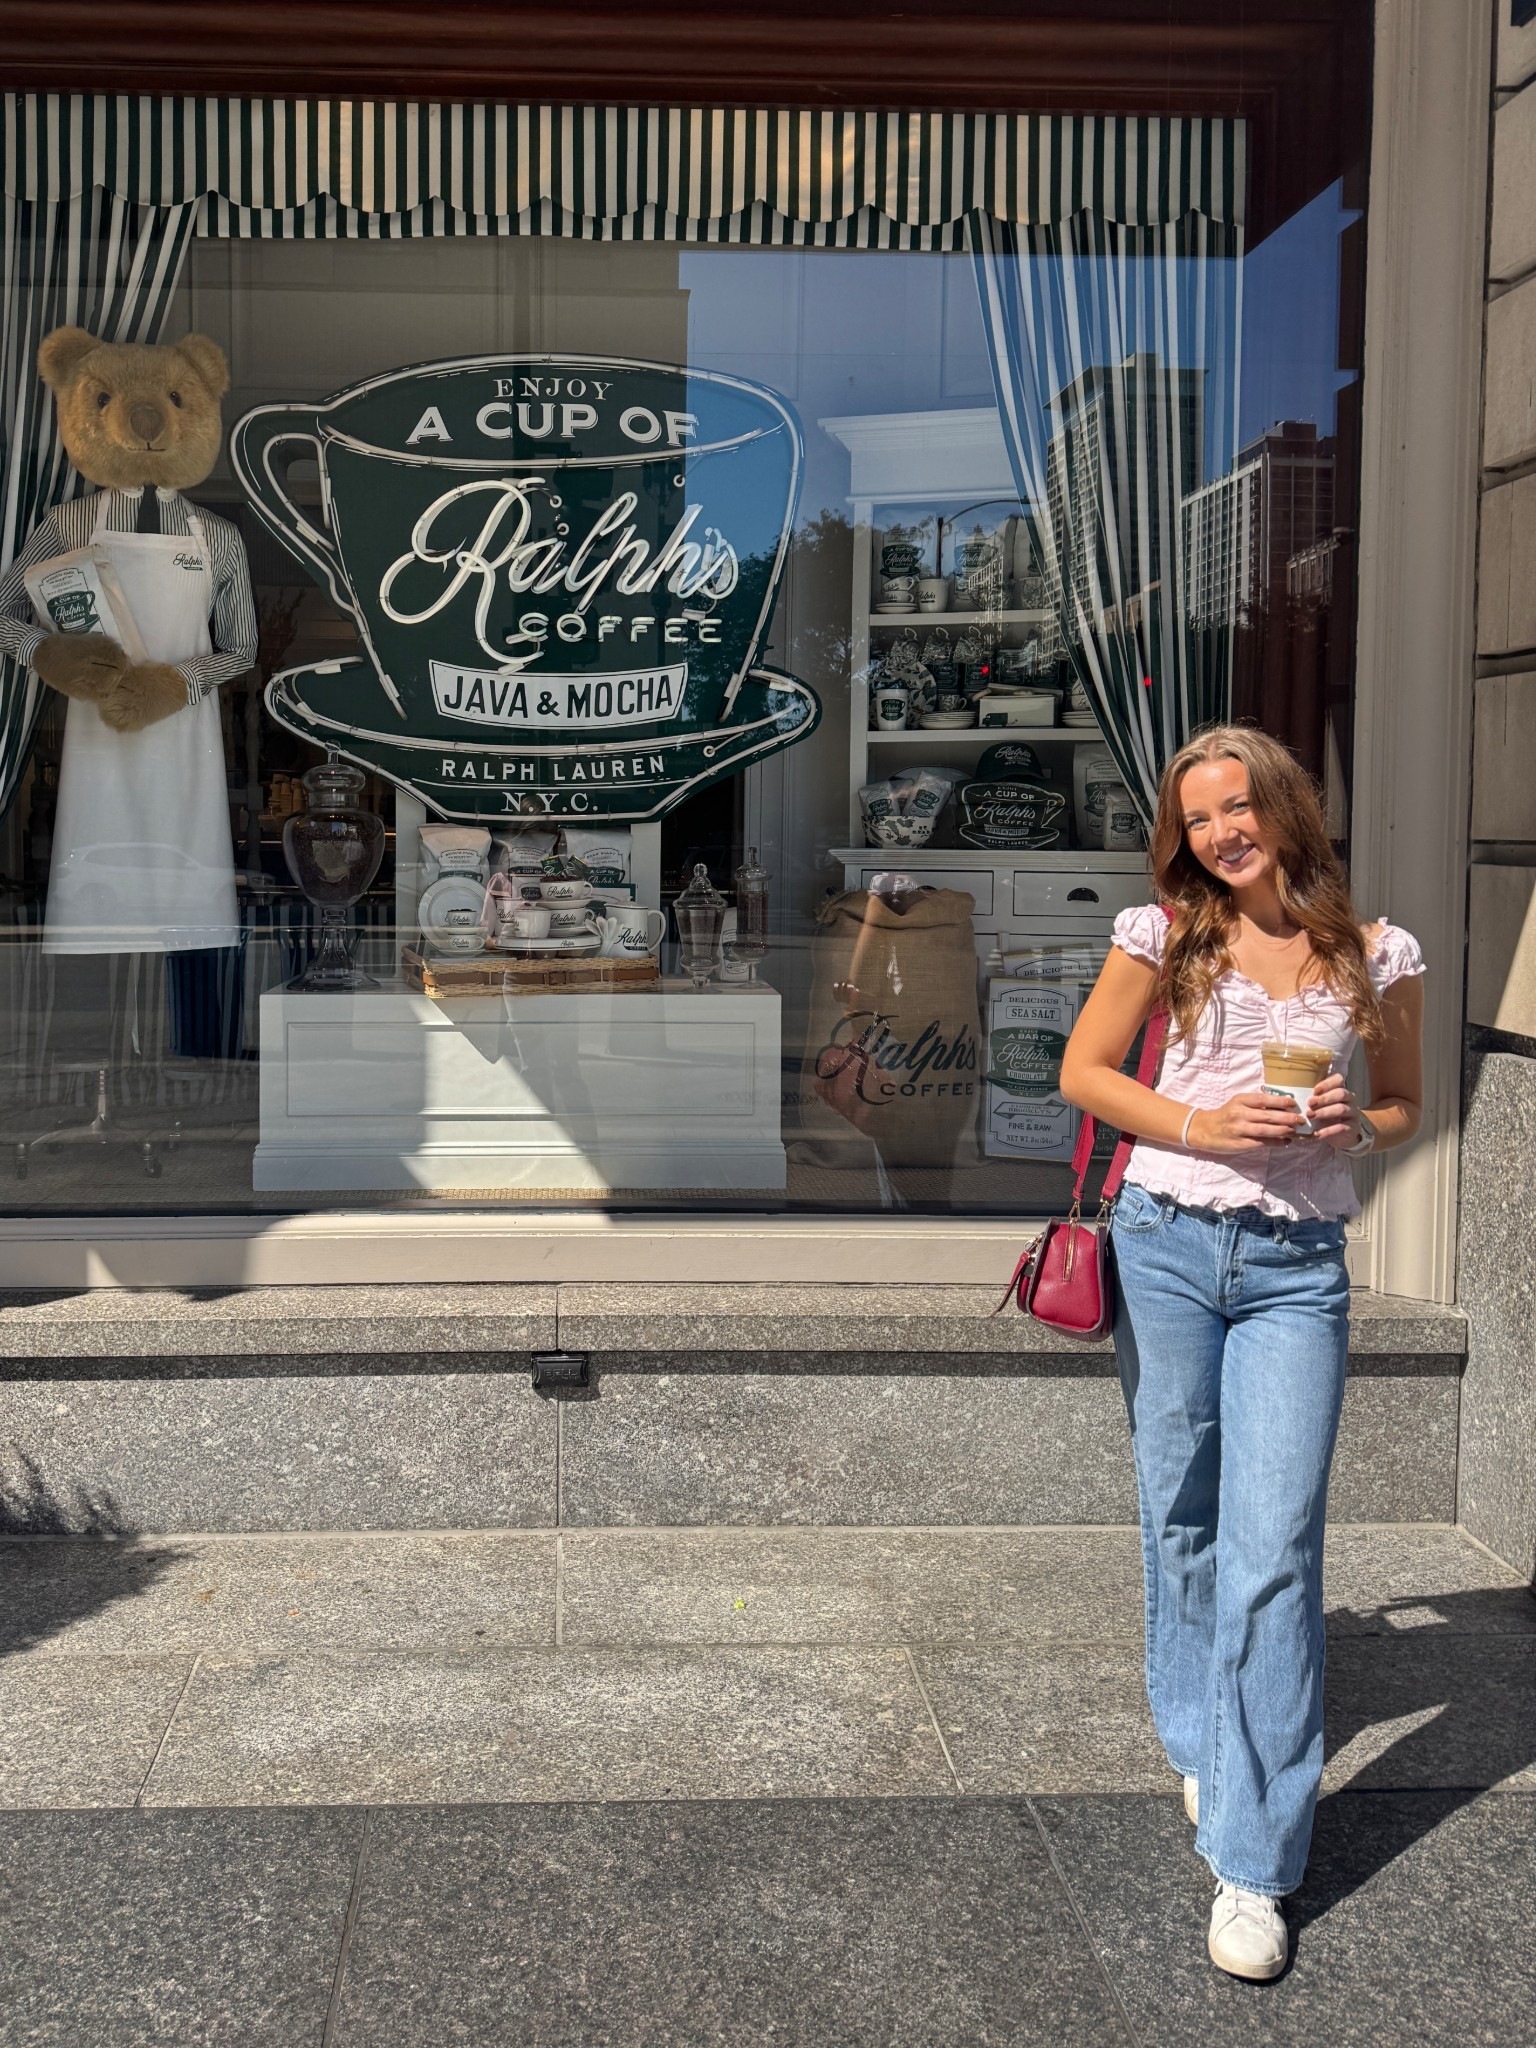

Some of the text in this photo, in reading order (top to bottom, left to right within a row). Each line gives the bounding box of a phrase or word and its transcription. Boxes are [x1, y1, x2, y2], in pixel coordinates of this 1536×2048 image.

[494, 377, 613, 401] ENJOY
[405, 402, 699, 446] A CUP OF
[172, 552, 203, 568] Ralph's
[380, 477, 738, 662] Ralph's
[54, 602, 85, 623] Ralph's
[518, 612, 723, 644] COFFEE
[444, 674, 675, 720] JAVA & MOCHA
[994, 745, 1031, 760] Ralph's
[440, 755, 666, 782] RALPH LAUREN
[501, 792, 600, 814] N.Y.C.
[995, 790, 1018, 798] CUP
[1020, 793, 1035, 801] OF
[973, 801, 1036, 826] Ralph's
[997, 818, 1034, 827] COFFEE
[547, 886, 574, 898] Ralph's
[551, 913, 577, 925] Ralph's
[1024, 965, 1073, 977] DELICIOUS
[1009, 996, 1059, 1005] DELICIOUS
[1011, 1008, 1056, 1019] SEA SALT
[1018, 1033, 1039, 1041] BAR
[1040, 1034, 1054, 1042] OF
[815, 1010, 977, 1106] Ralph's
[997, 1042, 1050, 1070] Ralph's
[1013, 1061, 1055, 1071] COFFEE
[1009, 1071, 1045, 1081] CHOCOLATE
[880, 1082, 974, 1097] COFFEE
[1008, 1107, 1052, 1115] BROOKLYN
[1008, 1122, 1052, 1132] FINE & RAW
[1006, 1134, 1019, 1142] NET
